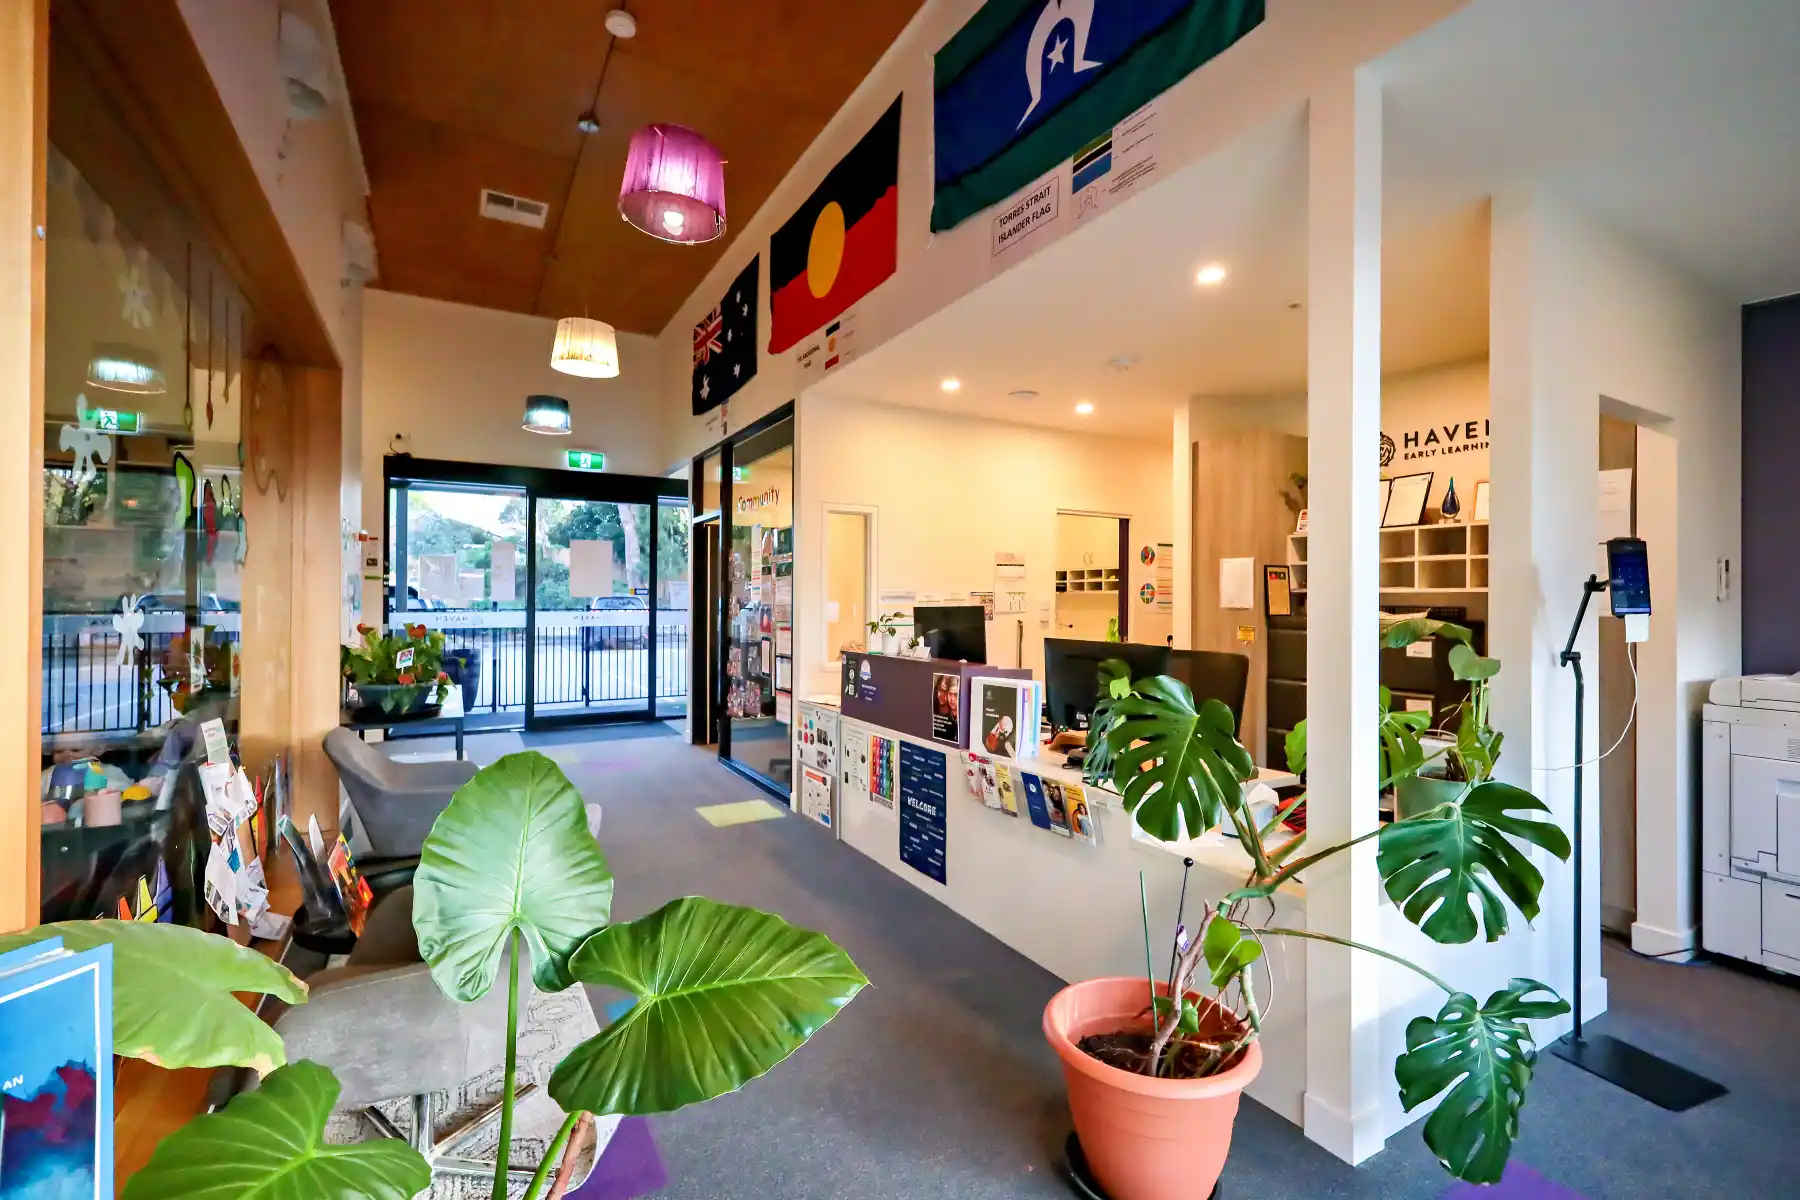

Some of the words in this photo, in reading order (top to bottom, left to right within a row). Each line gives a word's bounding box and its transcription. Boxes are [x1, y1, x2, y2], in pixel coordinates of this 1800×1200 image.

[998, 216, 1031, 244] ISLANDER
[1032, 203, 1051, 222] FLAG
[999, 204, 1025, 228] TORRES
[1025, 185, 1052, 210] STRAIT
[1404, 449, 1437, 460] EARLY
[737, 485, 780, 512] Community
